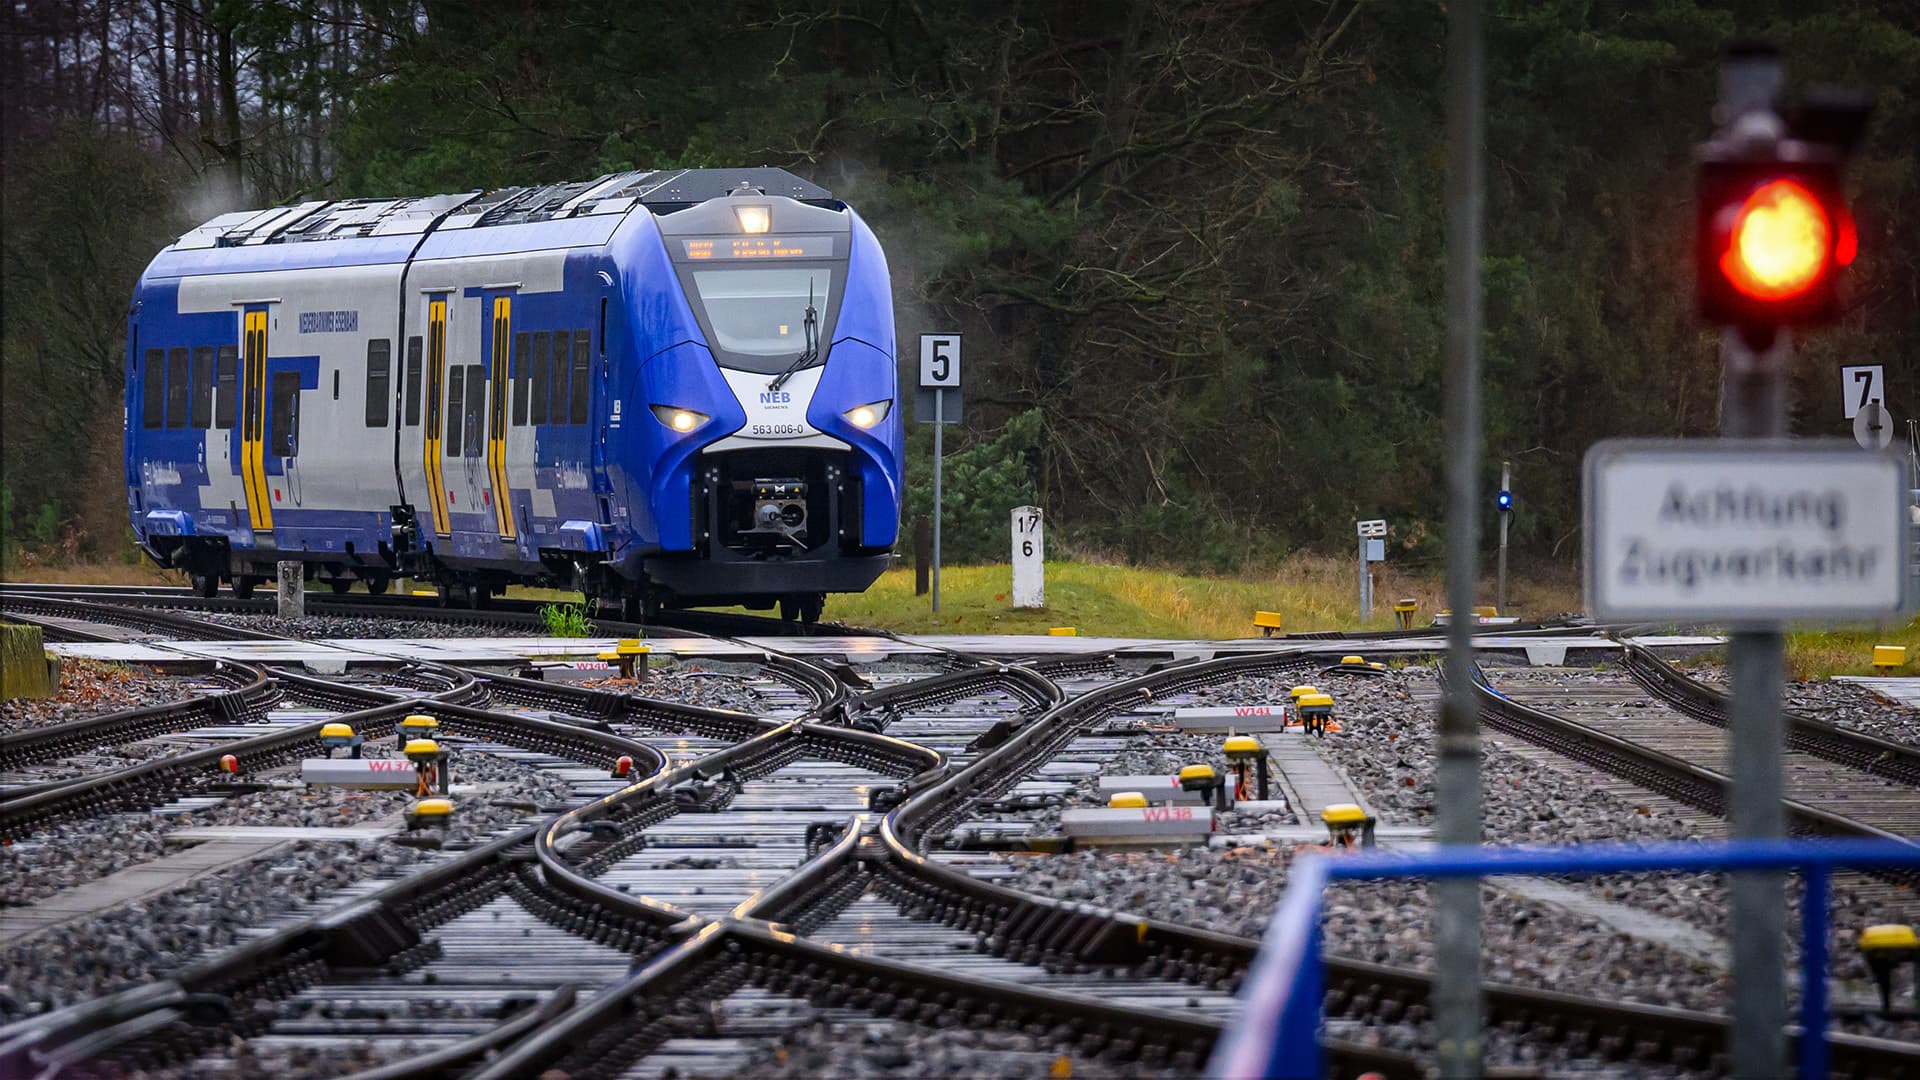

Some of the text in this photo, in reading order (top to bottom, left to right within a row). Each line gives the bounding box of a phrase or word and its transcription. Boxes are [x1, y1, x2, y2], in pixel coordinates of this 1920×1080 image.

[932, 340, 950, 381] 5
[760, 392, 791, 403] NEB
[1854, 371, 1873, 409] 7
[752, 424, 803, 434] 563 006-0
[1658, 483, 1846, 534] Achtung
[1018, 514, 1038, 533] 17
[1022, 540, 1033, 557] 6
[1619, 538, 1883, 592] Zugverkehr
[576, 662, 608, 670] W140
[1234, 707, 1272, 718] W141
[368, 760, 411, 772] W137
[1143, 807, 1193, 821] W138
